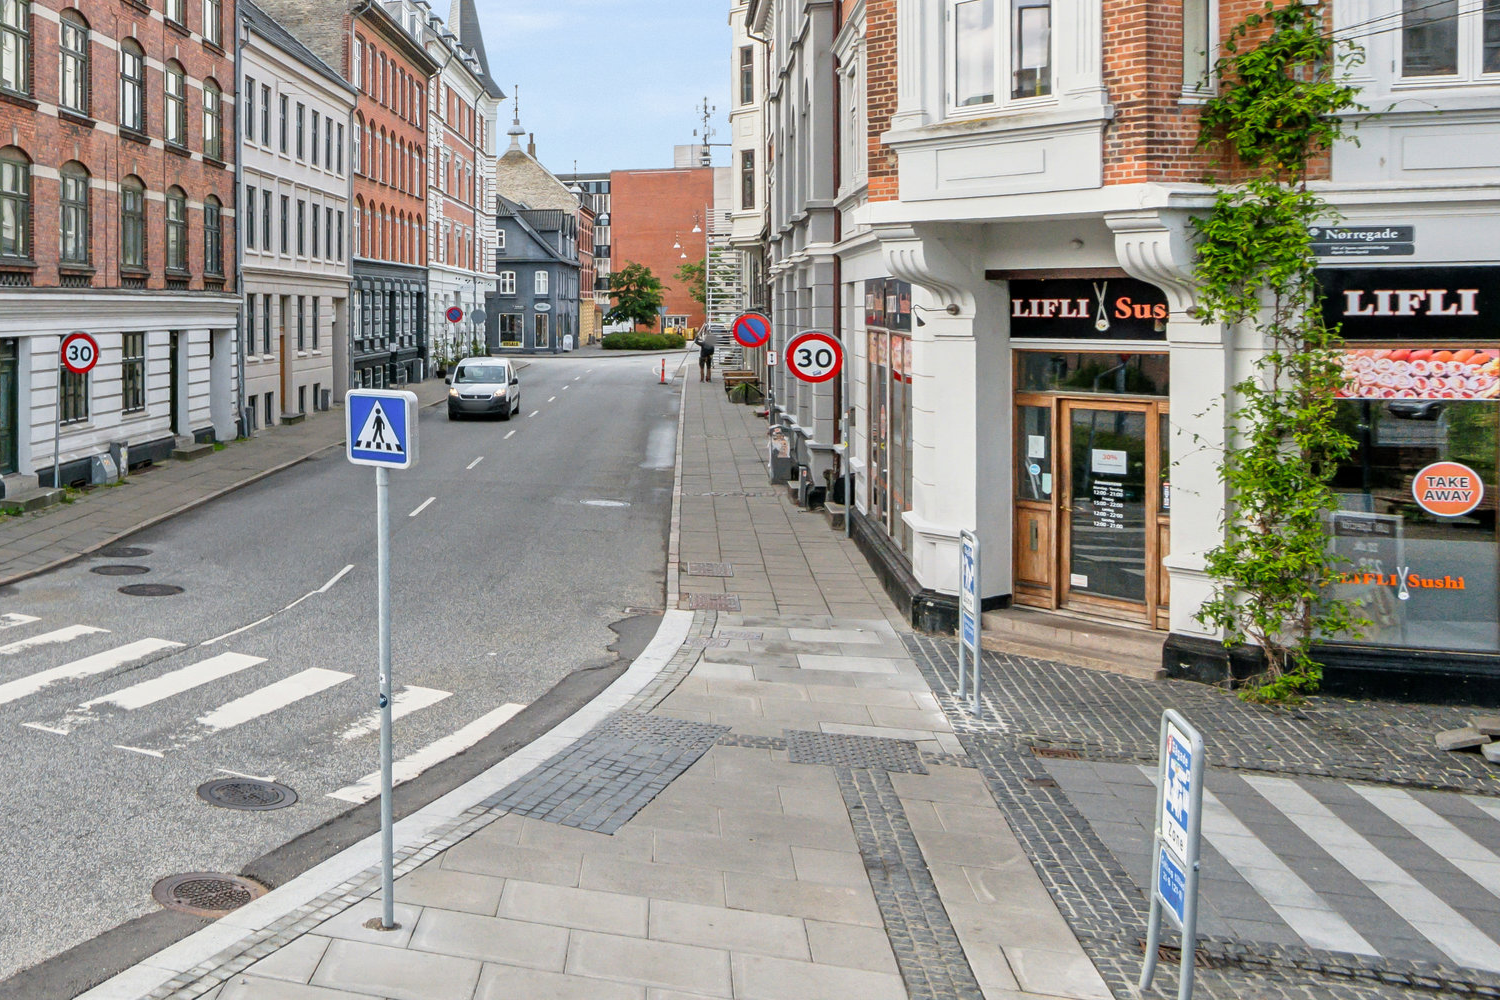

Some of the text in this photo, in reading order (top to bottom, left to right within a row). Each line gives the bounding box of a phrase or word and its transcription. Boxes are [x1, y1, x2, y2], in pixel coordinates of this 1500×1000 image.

[1325, 228, 1398, 241] Nørregade
[1011, 296, 1169, 319] LIFLI Sus
[1343, 289, 1479, 316] LIFLI
[68, 345, 92, 362] 30
[797, 348, 833, 368] 30
[1425, 476, 1469, 488] TAKE
[1423, 490, 1472, 502] AWAY
[1408, 574, 1466, 590] Sushi
[1168, 820, 1184, 852] Zone
